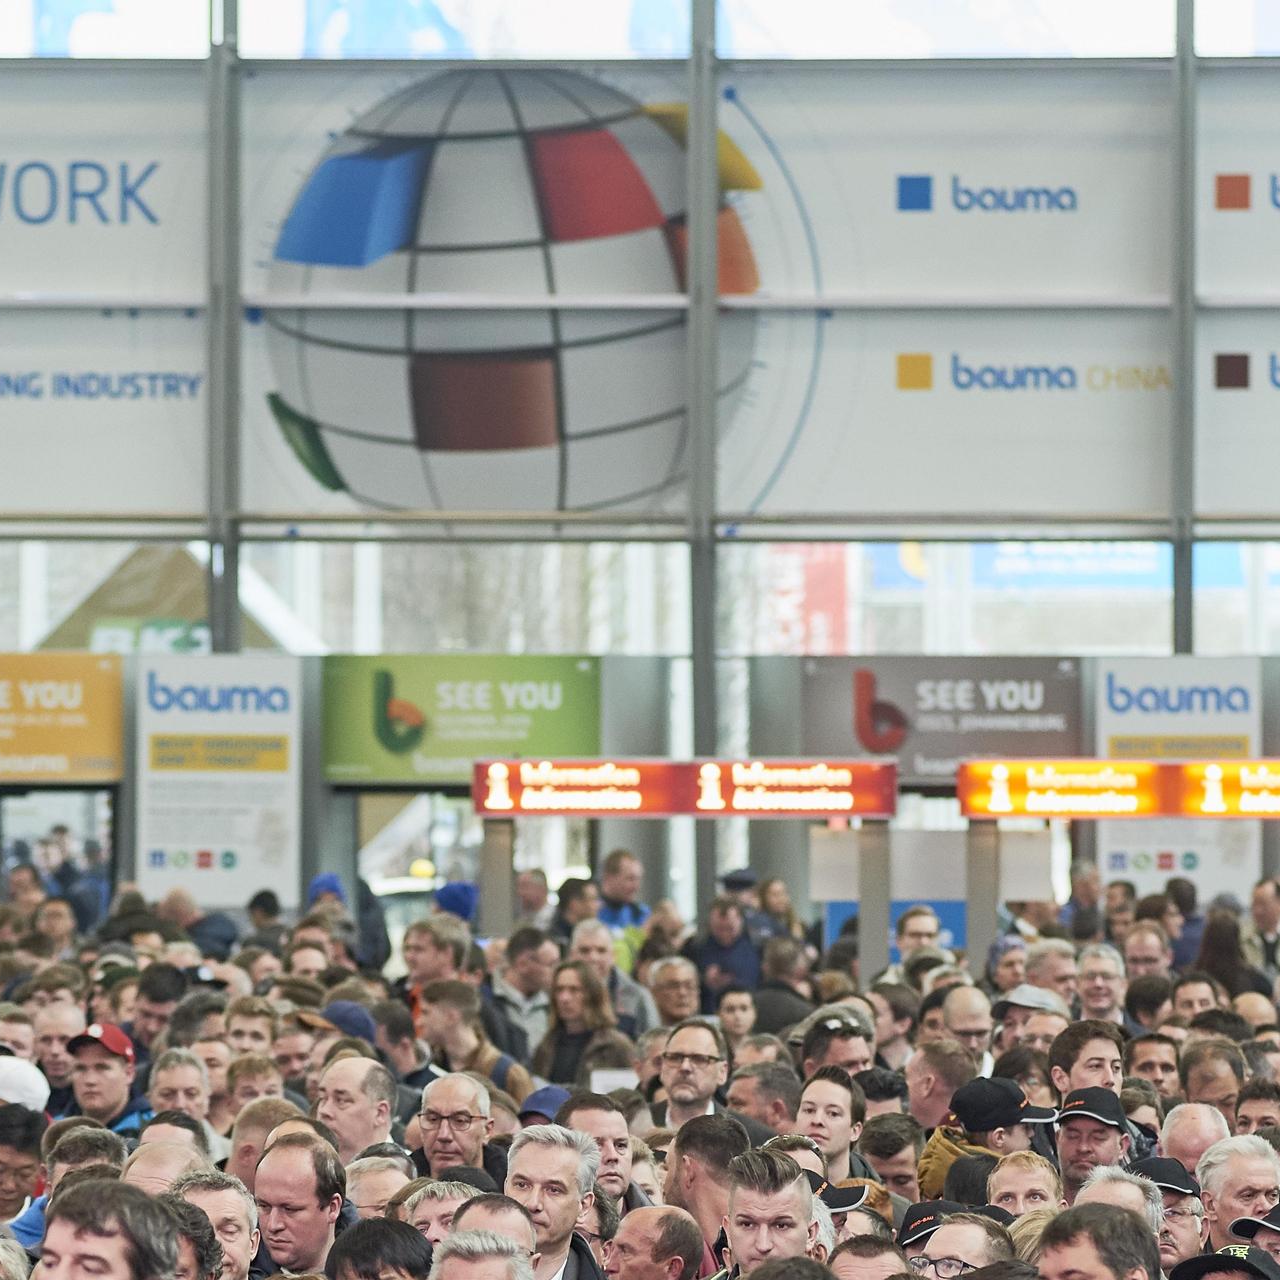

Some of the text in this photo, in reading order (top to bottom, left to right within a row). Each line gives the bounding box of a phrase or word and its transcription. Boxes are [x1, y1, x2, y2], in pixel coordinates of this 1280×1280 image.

[952, 175, 1077, 211] bauma
[52, 373, 202, 401] INDUSTRY
[952, 353, 1172, 392] bauma CHINA
[19, 680, 82, 709] YOU
[148, 671, 290, 712] bauma
[436, 681, 561, 711] SEE YOU
[916, 680, 1044, 711] SEE YOU
[1106, 672, 1250, 713] bauma
